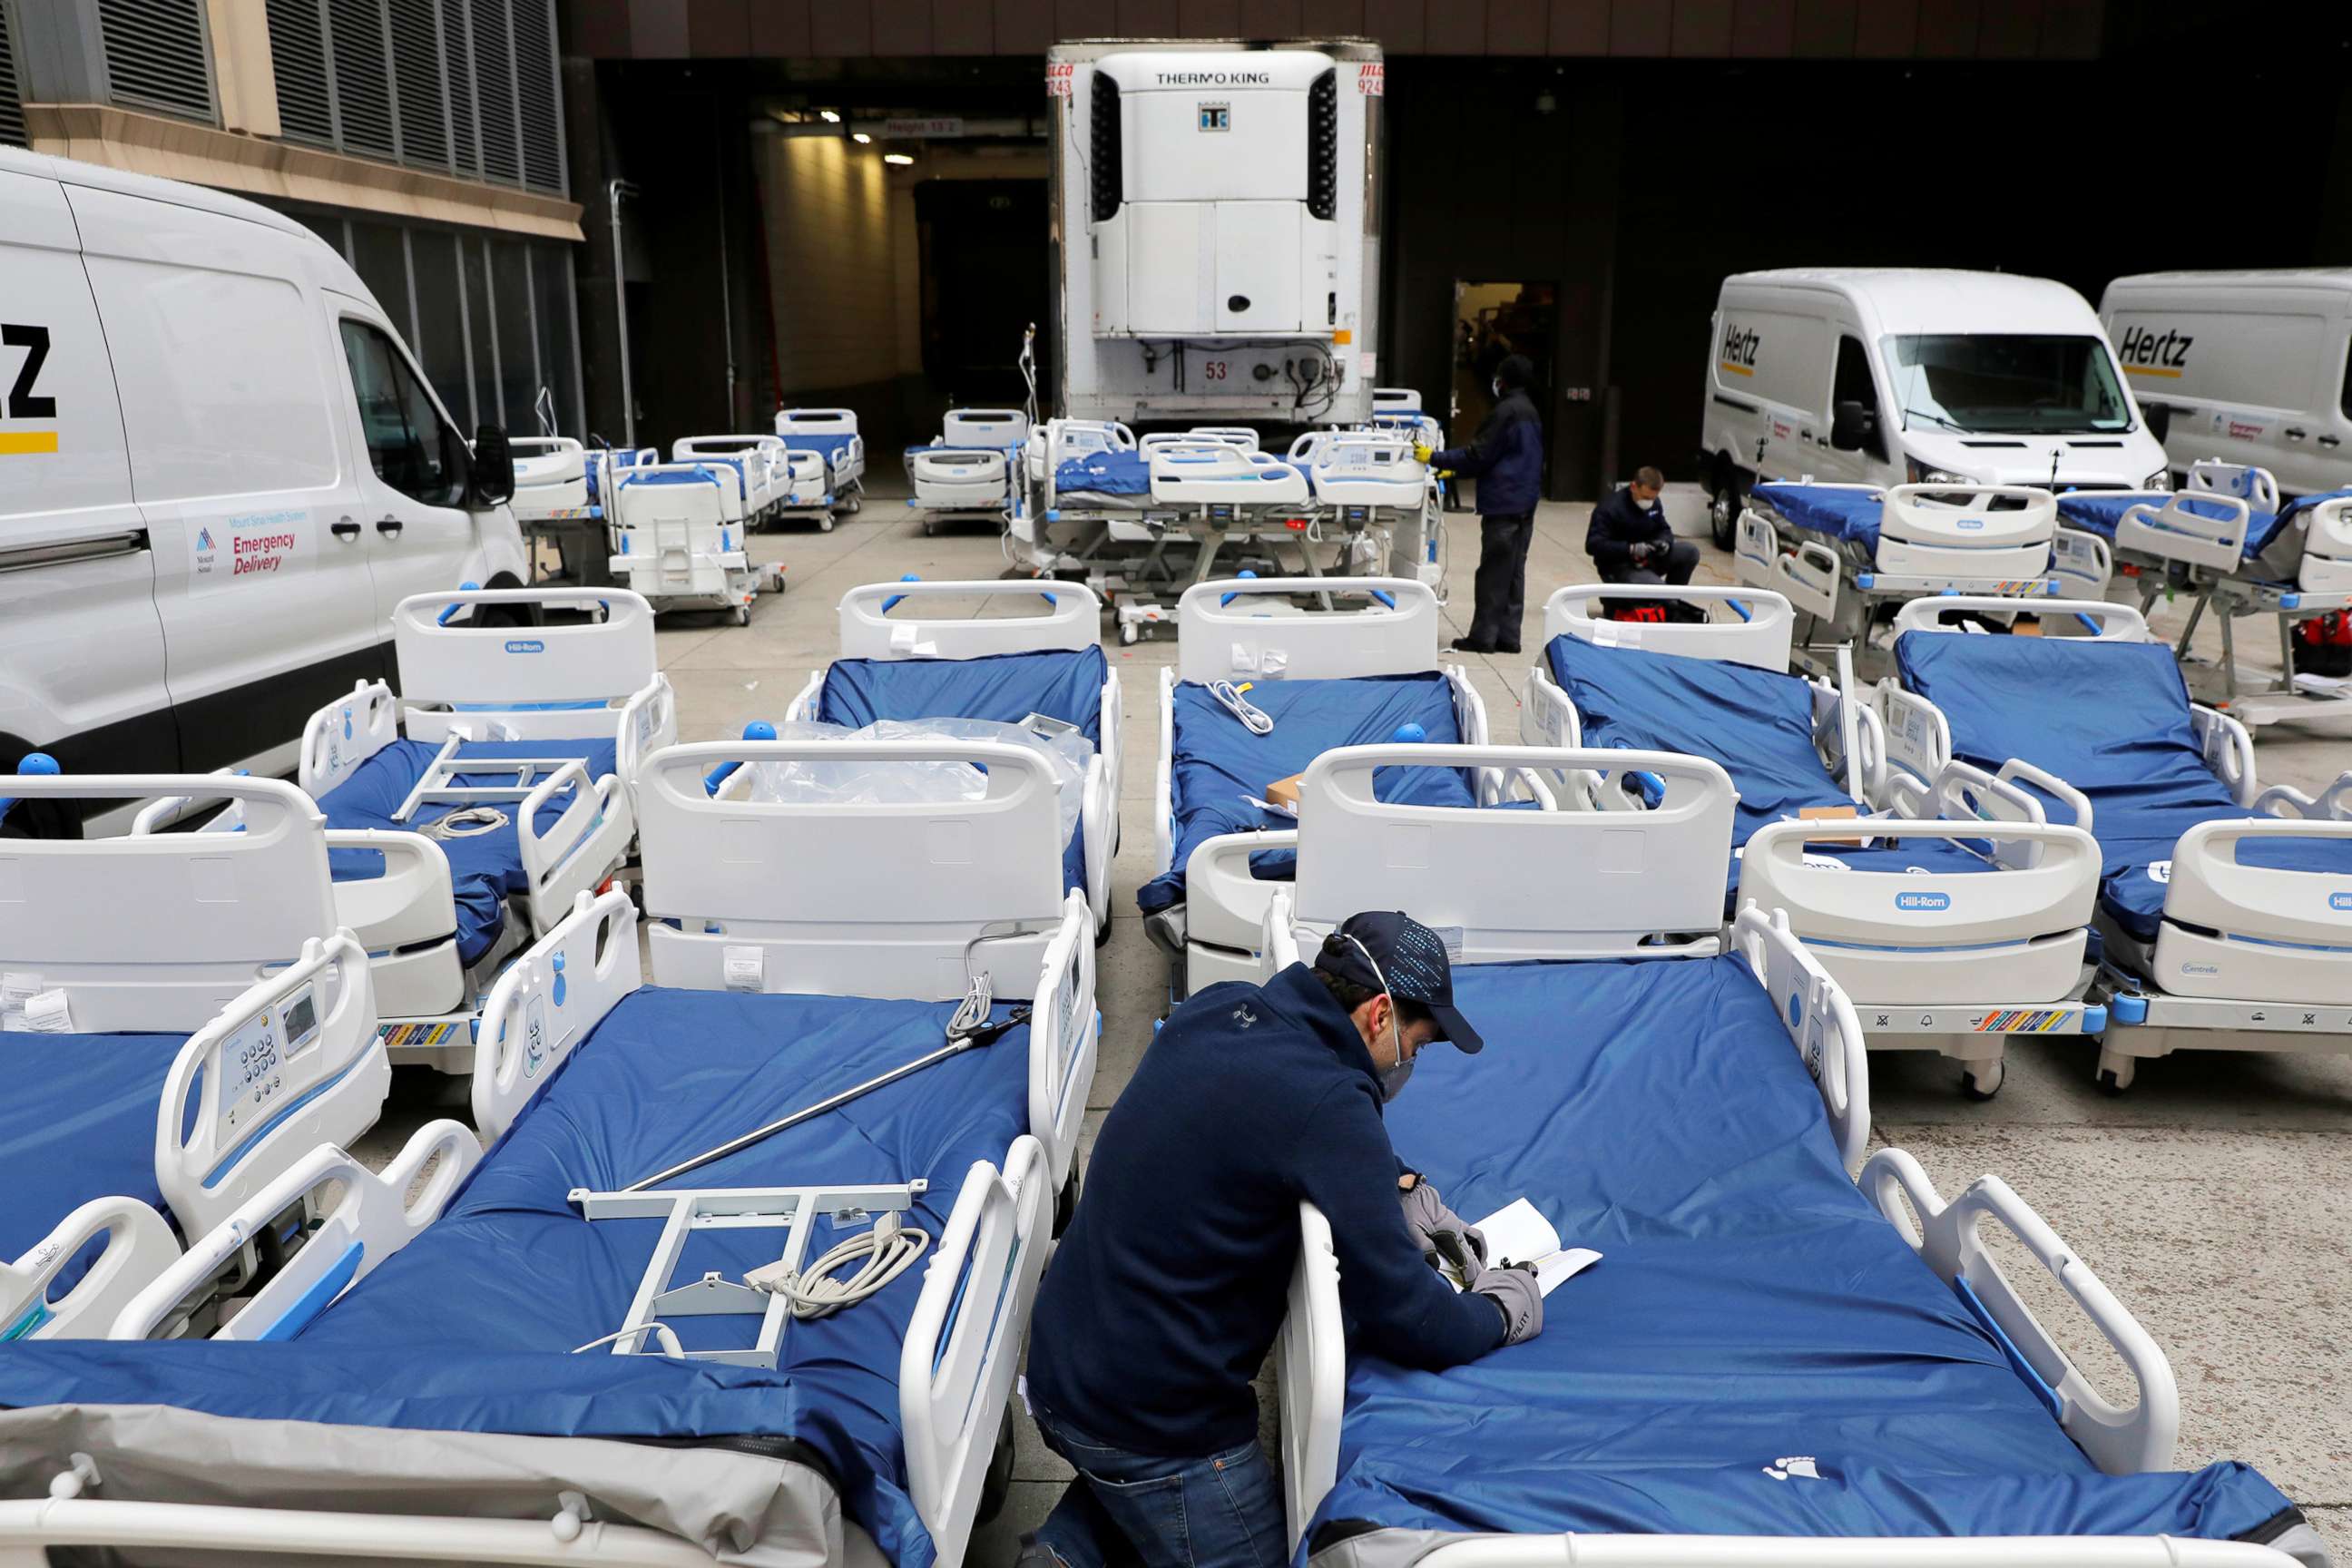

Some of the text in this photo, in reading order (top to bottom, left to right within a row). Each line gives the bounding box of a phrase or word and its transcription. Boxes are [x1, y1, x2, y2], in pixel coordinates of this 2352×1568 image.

[1156, 73, 1269, 84] THERMO KING
[1722, 323, 1759, 367] Hertz
[2119, 326, 2193, 367] Hertz
[1205, 361, 1226, 380] 53
[233, 534, 296, 554] Emergency
[233, 555, 281, 575] Delivery
[1901, 897, 1945, 906] Hill-Rom
[1510, 1311, 1530, 1343] UTILITY
